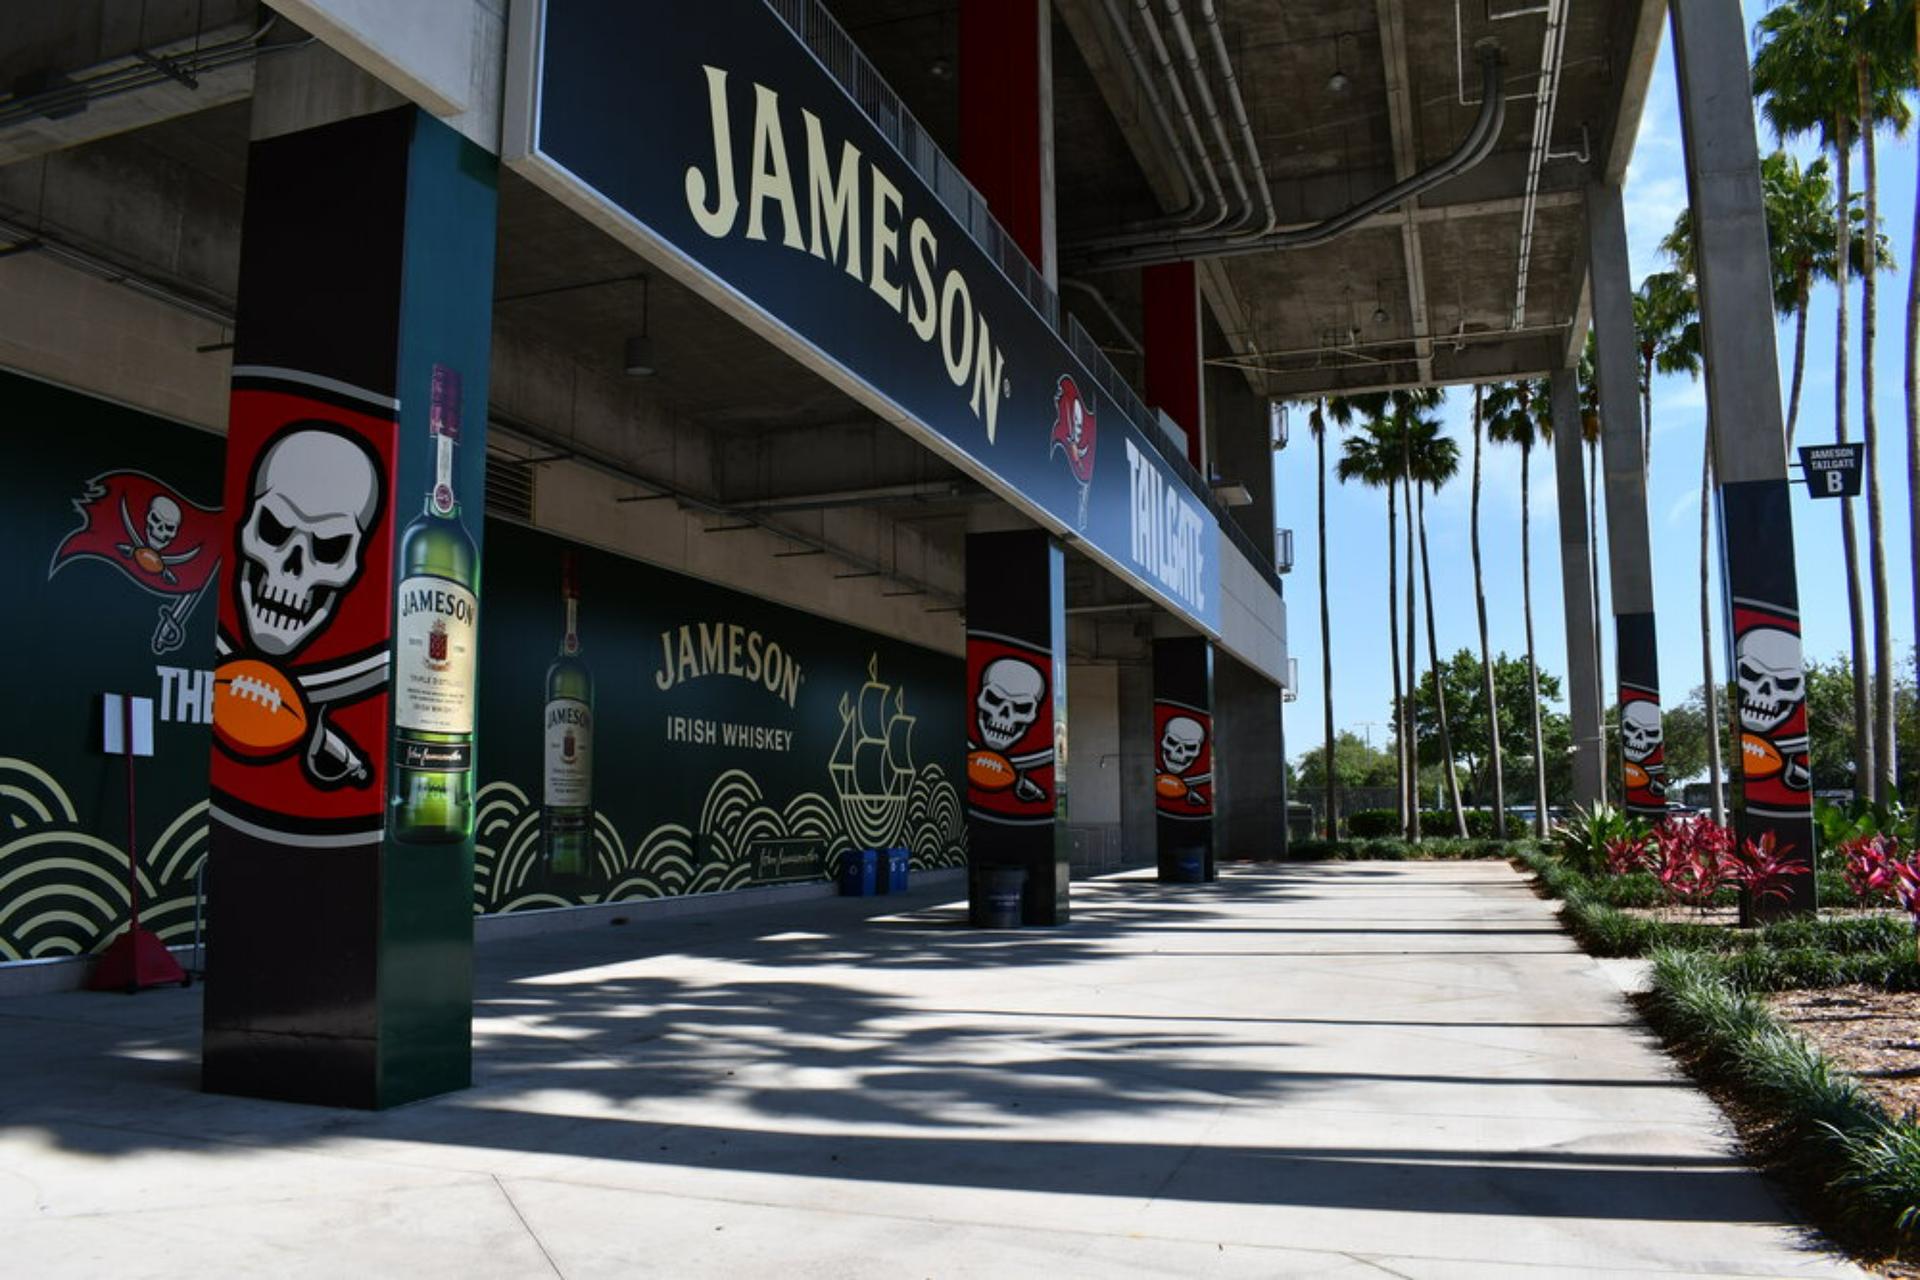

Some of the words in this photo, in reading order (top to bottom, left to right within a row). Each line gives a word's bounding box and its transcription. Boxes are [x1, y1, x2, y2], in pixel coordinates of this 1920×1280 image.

[685, 65, 1005, 445] JAMESON
[1811, 448, 1855, 459] JAMESON
[1812, 459, 1855, 470] TAILGATE
[1827, 471, 1843, 493] B
[1125, 437, 1205, 612] TAILGATE
[402, 589, 473, 627] JAMESON
[655, 622, 801, 709] JAMESON
[547, 707, 590, 730] JAMESO
[667, 715, 717, 745] IRISH
[722, 722, 793, 751] WHISKEY
